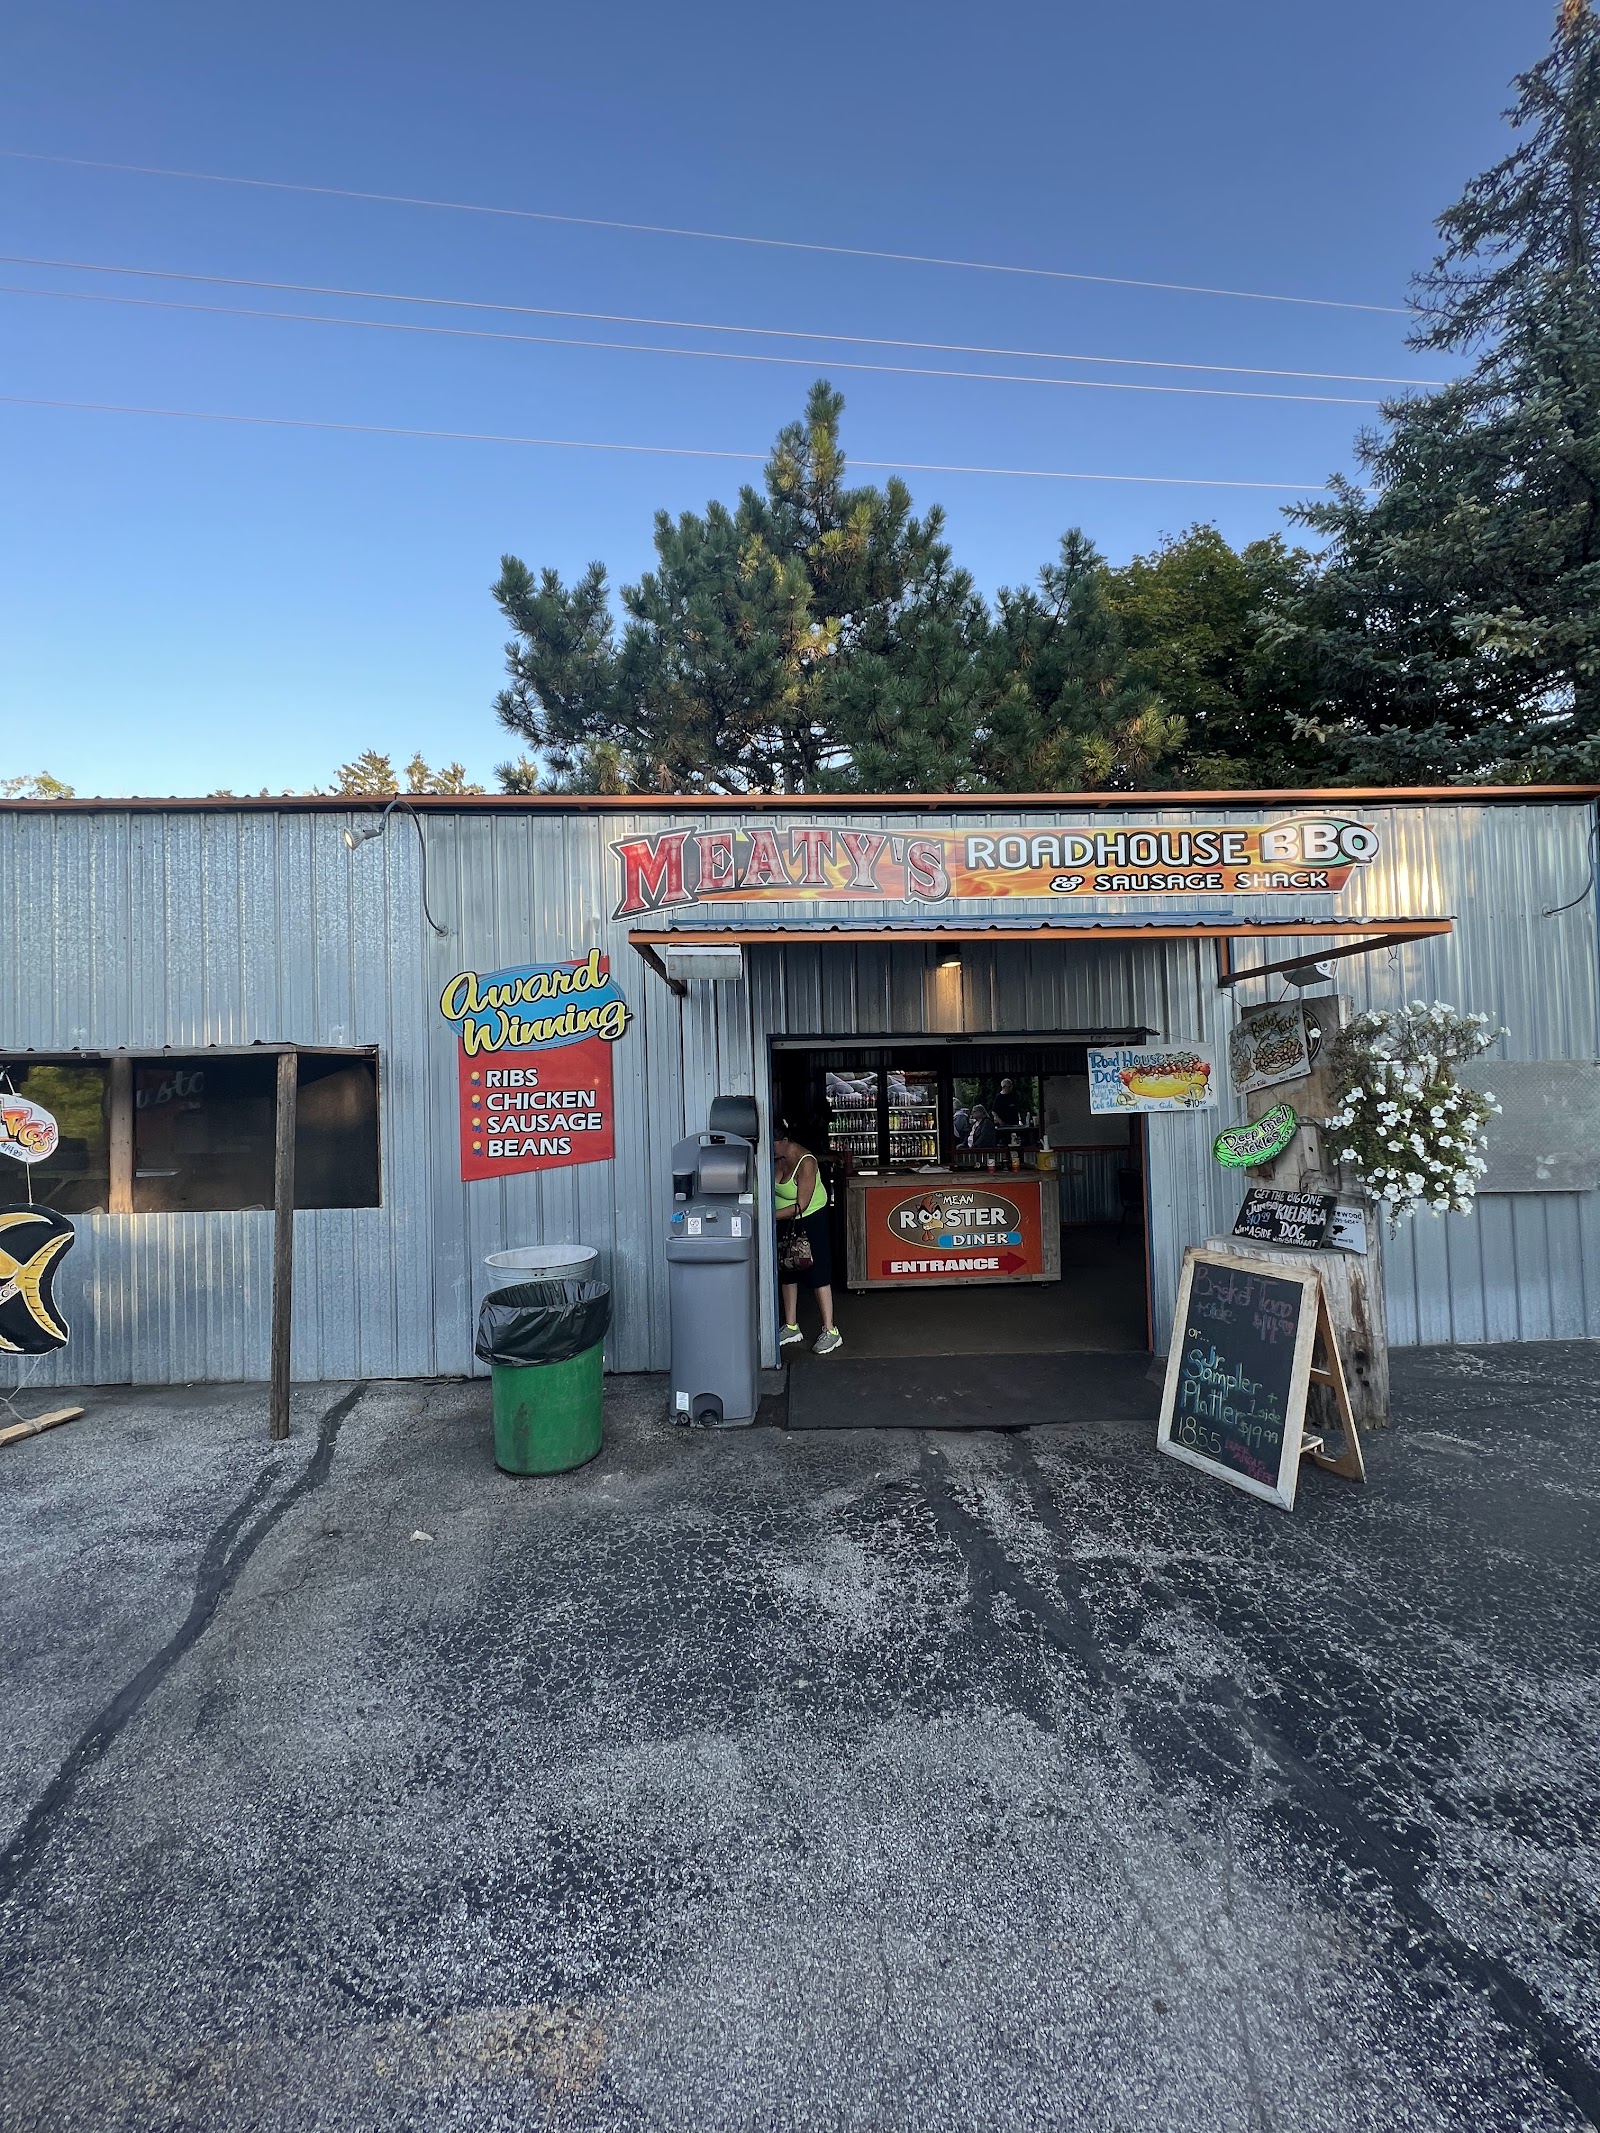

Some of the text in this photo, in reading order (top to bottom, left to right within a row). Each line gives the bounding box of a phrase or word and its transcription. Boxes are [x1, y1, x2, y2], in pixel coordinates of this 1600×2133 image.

[966, 824, 1379, 868] ROADHOUSE BBQ
[612, 827, 949, 919] MEATY'S
[1050, 871, 1329, 892] & SAUSAGE SHACK
[440, 949, 609, 1020] Award
[462, 1001, 632, 1056] Winning
[486, 1068, 538, 1088] RIBS
[486, 1090, 596, 1110] CHICKEN
[487, 1112, 602, 1133] SAUSAGE
[487, 1137, 572, 1157] BEANS
[943, 1193, 974, 1206] MEAN
[1254, 1189, 1324, 1206] GET THE BIG ONE
[900, 1207, 1008, 1229] ROOSTER
[1275, 1204, 1328, 1226] KIELBASA
[1333, 1210, 1362, 1220] rewood
[952, 1233, 1009, 1246] DINER
[1255, 1227, 1272, 1239] SIDE
[1279, 1221, 1306, 1239] DOG
[890, 1257, 999, 1273] ENTRANCE
[1182, 1348, 1263, 1395] Sampler
[1181, 1380, 1248, 1425] Platter
[1178, 1415, 1222, 1454] 1855
